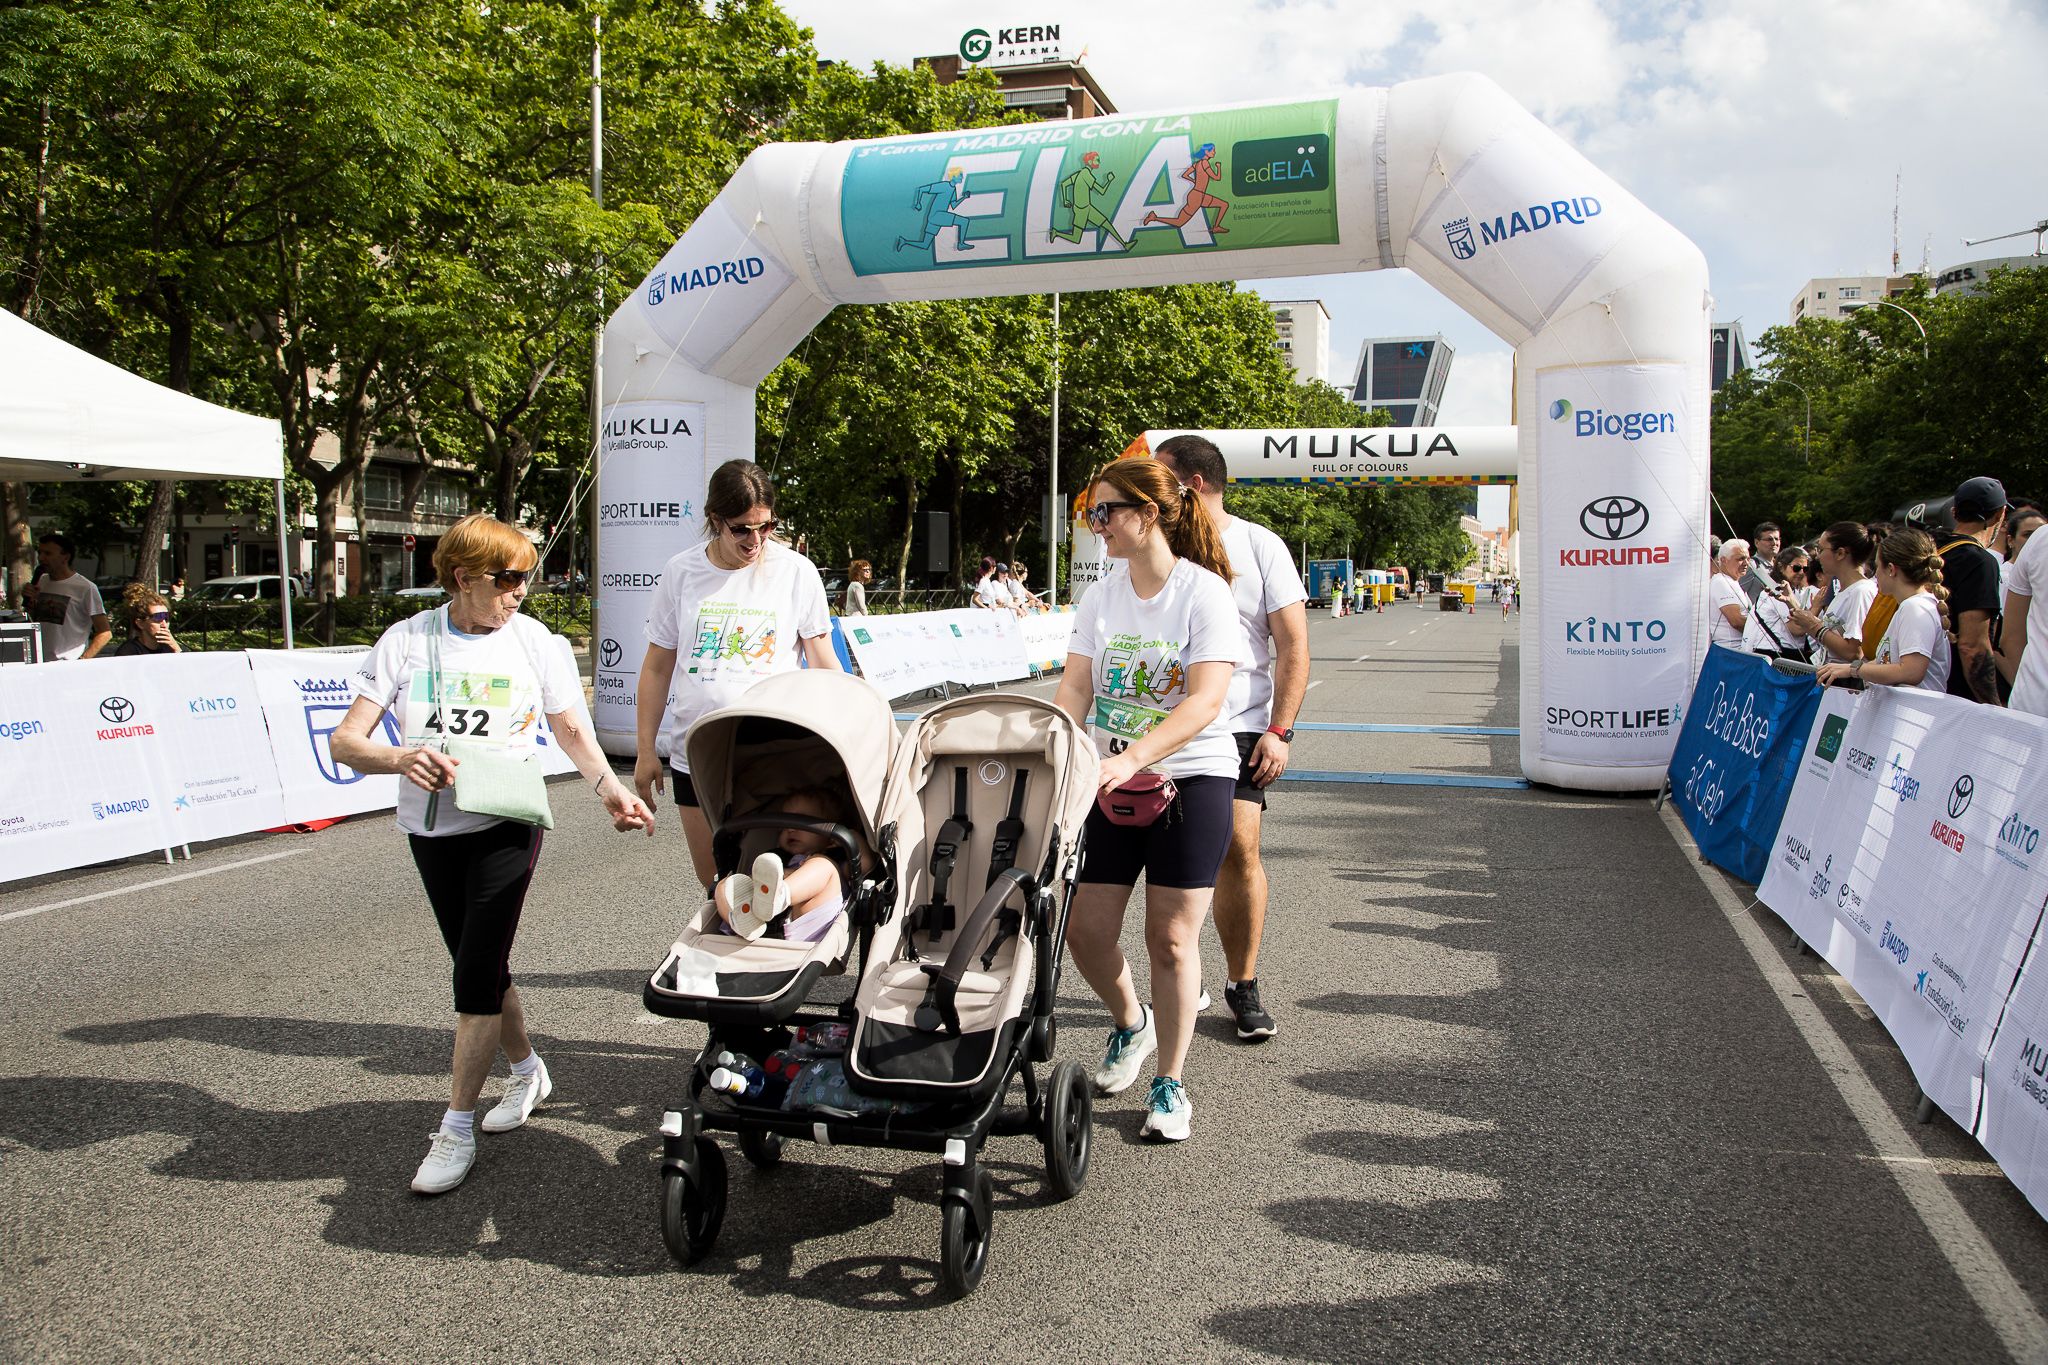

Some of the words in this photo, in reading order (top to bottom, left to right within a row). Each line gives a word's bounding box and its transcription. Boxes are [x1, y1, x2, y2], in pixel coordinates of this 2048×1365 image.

[999, 25, 1060, 45] KERN
[999, 46, 1059, 57] PHARMA
[881, 141, 948, 157] Carrera
[953, 128, 1073, 152] MADRID
[1080, 120, 1146, 140] CON
[1152, 116, 1192, 133] LA
[934, 134, 1217, 265] ELA
[1233, 202, 1269, 210] Asociación
[1302, 198, 1312, 206] de
[1268, 209, 1291, 218] Lateral
[1479, 196, 1602, 246] MADRID
[671, 257, 765, 295] MADRID
[602, 418, 692, 440] MUKUA
[1575, 409, 1675, 441] Biogen
[1263, 433, 1459, 459] MUKUA
[1313, 464, 1336, 473] FULL
[1339, 464, 1354, 473] OF
[1357, 463, 1409, 472] COLOURS
[1566, 647, 1595, 656] Flexible
[1597, 648, 1629, 657] Mobility
[1631, 647, 1667, 656] Solutions
[1547, 706, 1670, 729] SPORTLIFE
[1705, 680, 1728, 735] De
[425, 707, 490, 737] 432
[1581, 730, 1633, 739] COMUNICACIÓN
[1640, 729, 1669, 738] EVENTOS
[106, 798, 150, 816] MADRID
[2020, 1037, 2048, 1084] MU
